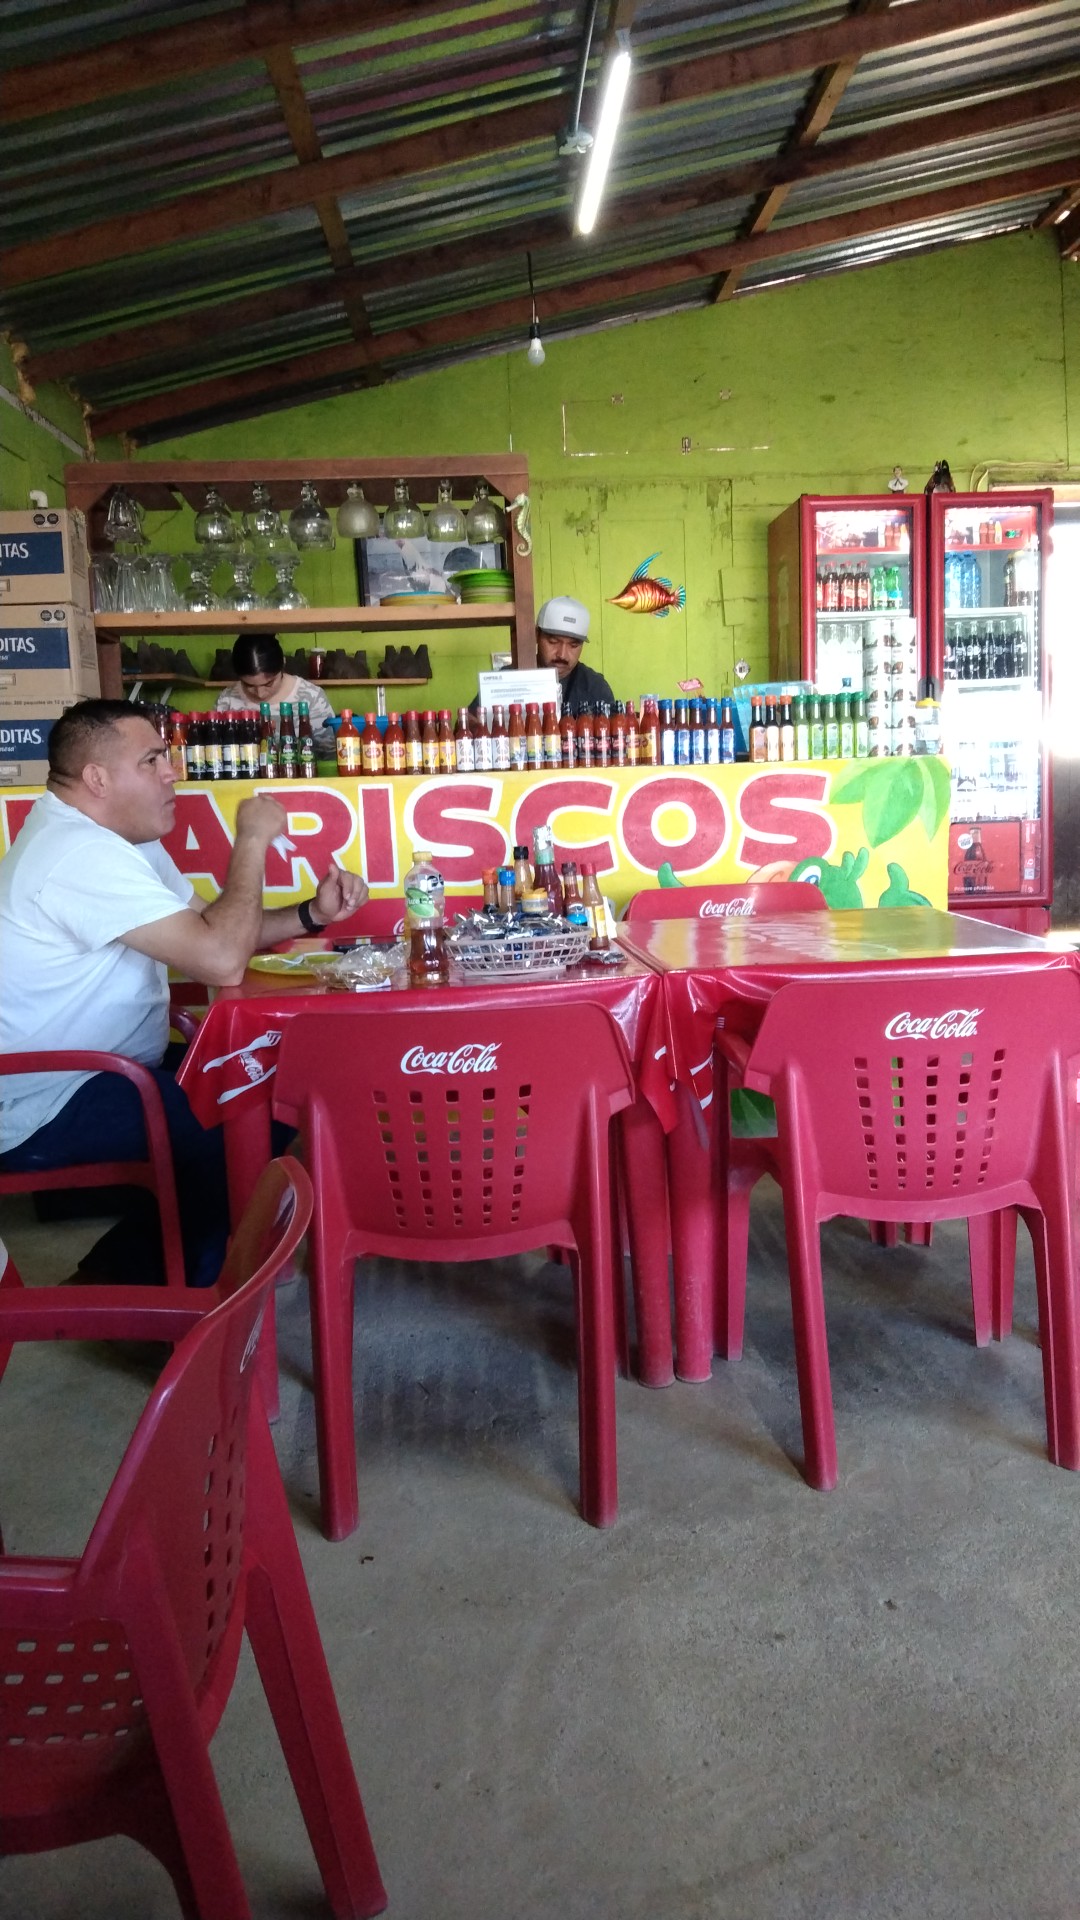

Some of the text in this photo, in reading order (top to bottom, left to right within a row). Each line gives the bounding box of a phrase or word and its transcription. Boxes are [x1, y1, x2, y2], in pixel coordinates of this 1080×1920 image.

[0, 728, 43, 745] DITAS
[2, 768, 838, 892] ARISCOS
[699, 897, 757, 919] Coca-Cola
[884, 1007, 985, 1041] Coca-Cola
[400, 1042, 503, 1075] Coca-Cola
